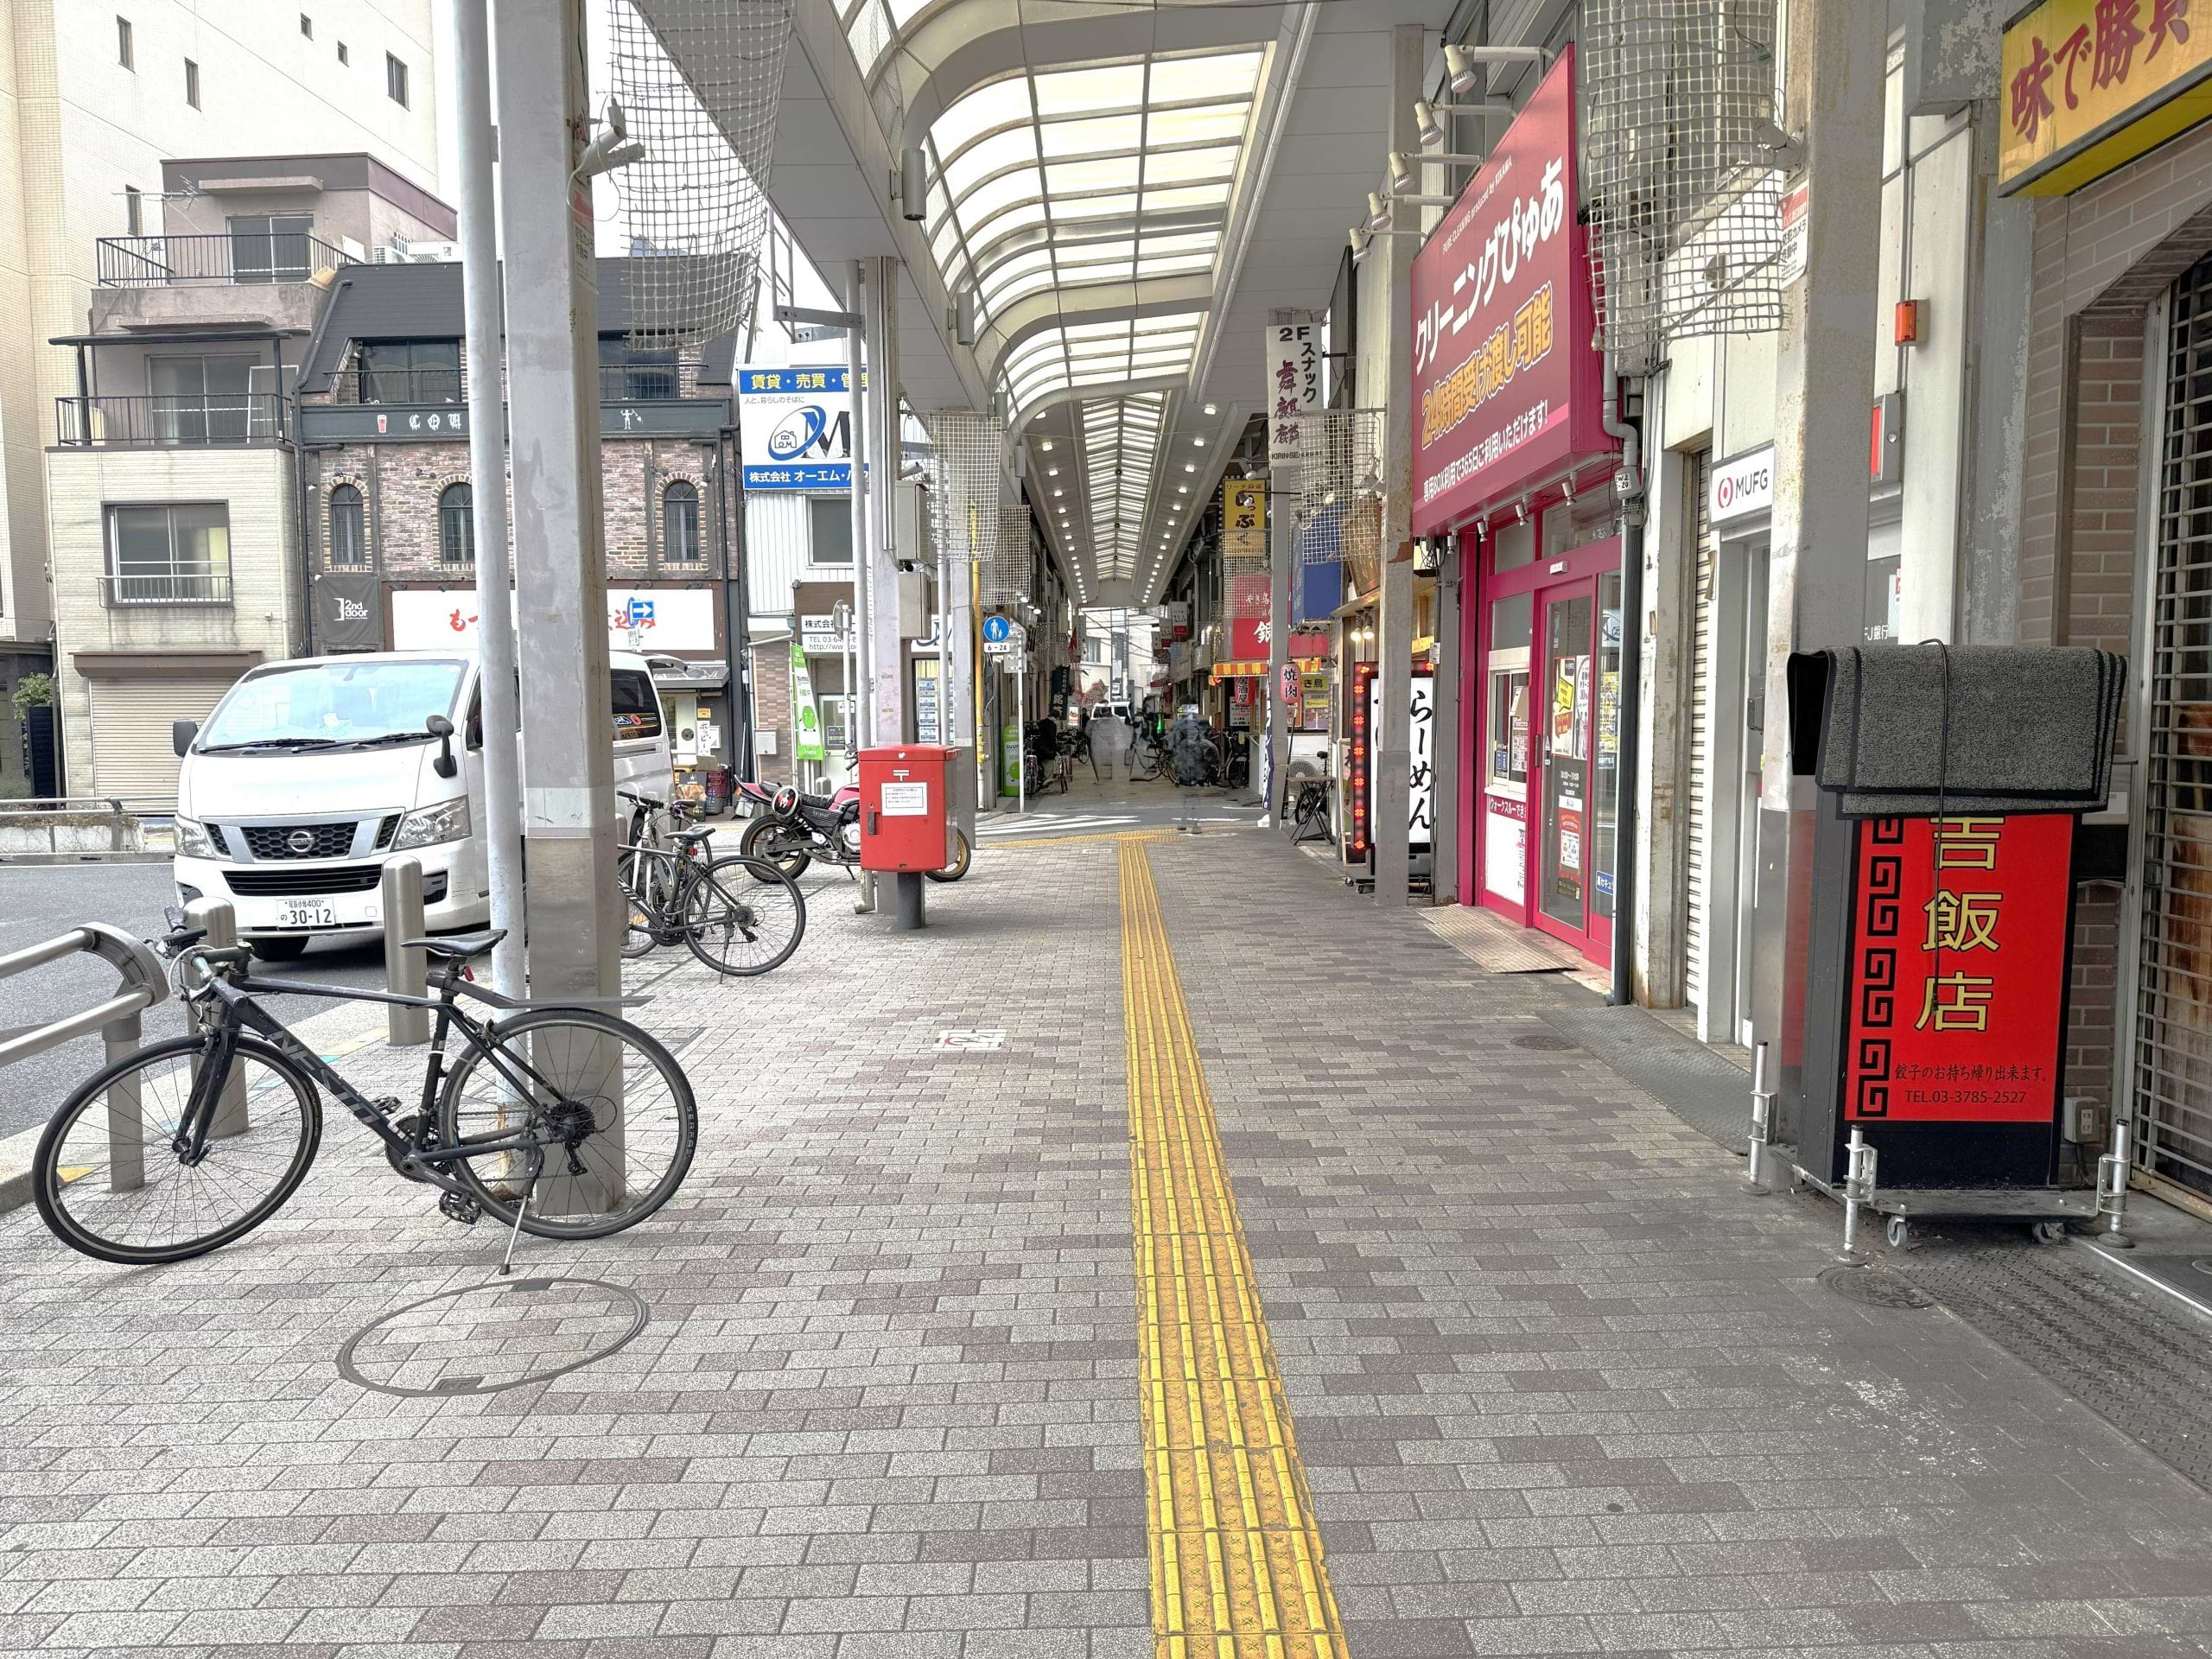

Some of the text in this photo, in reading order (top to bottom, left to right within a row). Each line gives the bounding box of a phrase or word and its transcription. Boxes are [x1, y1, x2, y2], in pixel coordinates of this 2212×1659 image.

[1415, 156, 1563, 377] クリーニングぴゅあ
[1279, 327, 1310, 342] 2F
[1300, 342, 1317, 403] スナック
[1422, 281, 1552, 450] 24時間受け渡し可能
[749, 471, 791, 483] 株式会社
[1735, 467, 1769, 502] MUFG
[345, 599, 364, 610] 2nd
[345, 607, 369, 617] door
[1283, 667, 1298, 698] 焼肉
[1409, 690, 1433, 831] らーめん
[289, 908, 333, 925] 30-12
[1894, 1063, 2048, 1083] 餃子のお持ち帰り出来ます。
[1904, 1090, 2027, 1104] TEL.03-3785-2527
